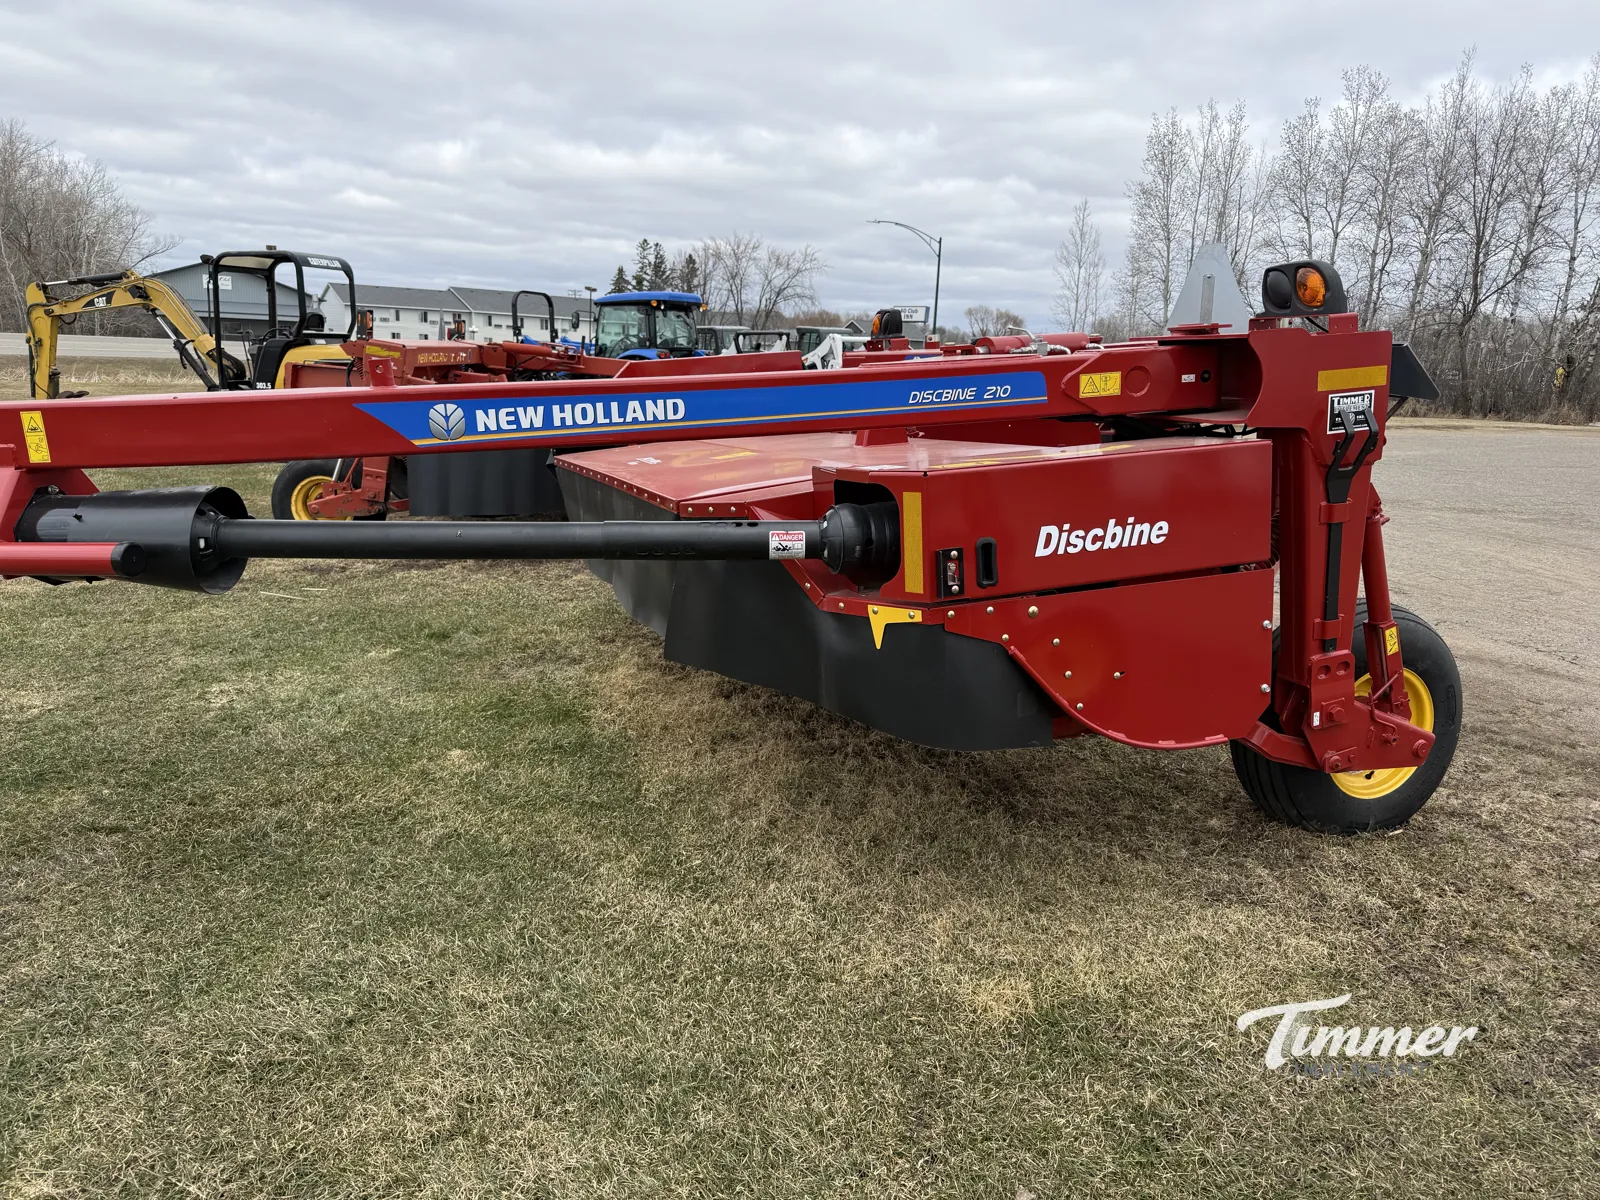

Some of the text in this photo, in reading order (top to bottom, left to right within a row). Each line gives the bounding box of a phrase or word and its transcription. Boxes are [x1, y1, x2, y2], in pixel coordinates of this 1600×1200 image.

[307, 257, 342, 268] CATERPILLAR
[94, 297, 107, 307] CAT
[908, 385, 1011, 404] DISCBINE 210
[1332, 394, 1371, 407] TIMMER
[475, 398, 686, 432] NEW HOLLAND
[1034, 516, 1169, 558] Discbine
